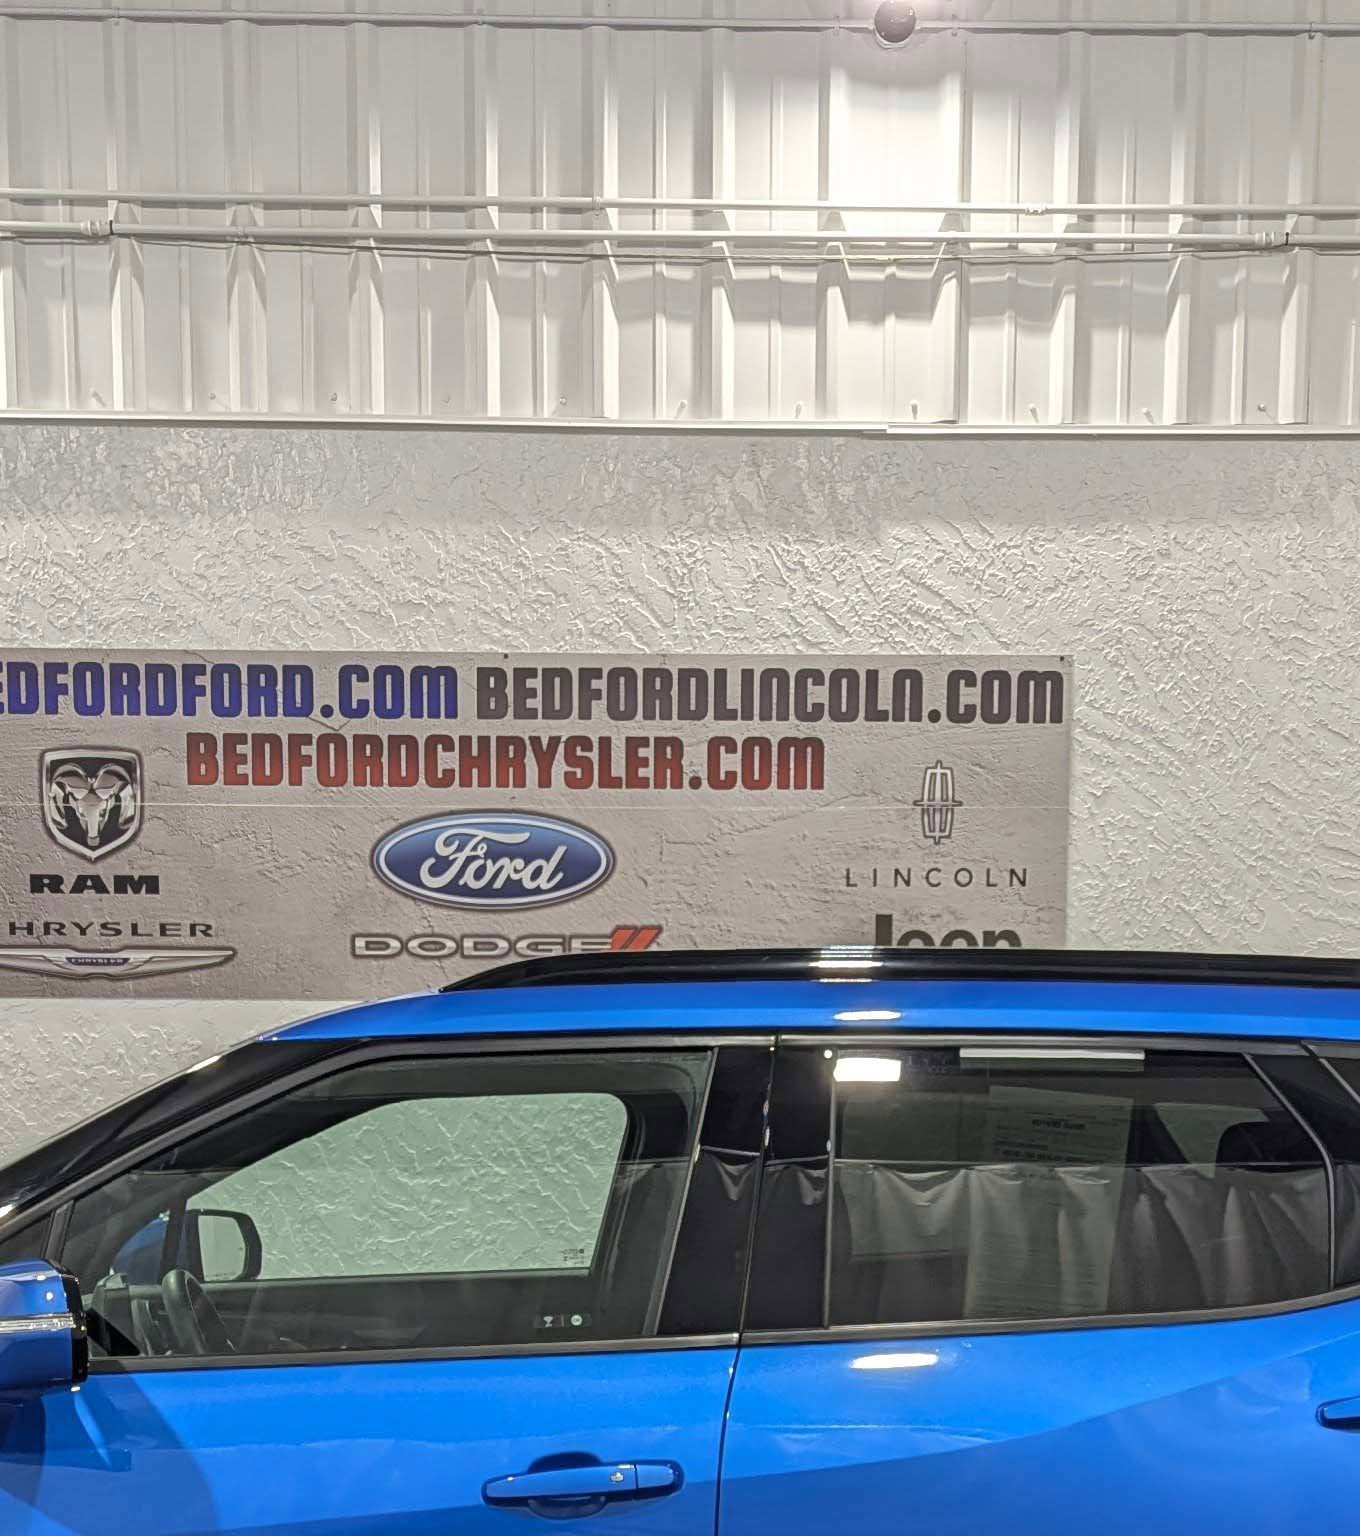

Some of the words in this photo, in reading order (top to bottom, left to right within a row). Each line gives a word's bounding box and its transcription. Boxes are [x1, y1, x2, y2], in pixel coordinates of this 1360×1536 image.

[476, 666, 1064, 725] BEDFORDLINCOLN.COM
[186, 731, 825, 791] BEDFORDCHRYSLER.COM
[419, 828, 568, 890] Ford
[845, 867, 1028, 888] LINCOLN
[29, 873, 161, 896] RAM
[350, 933, 613, 958] DODGE
